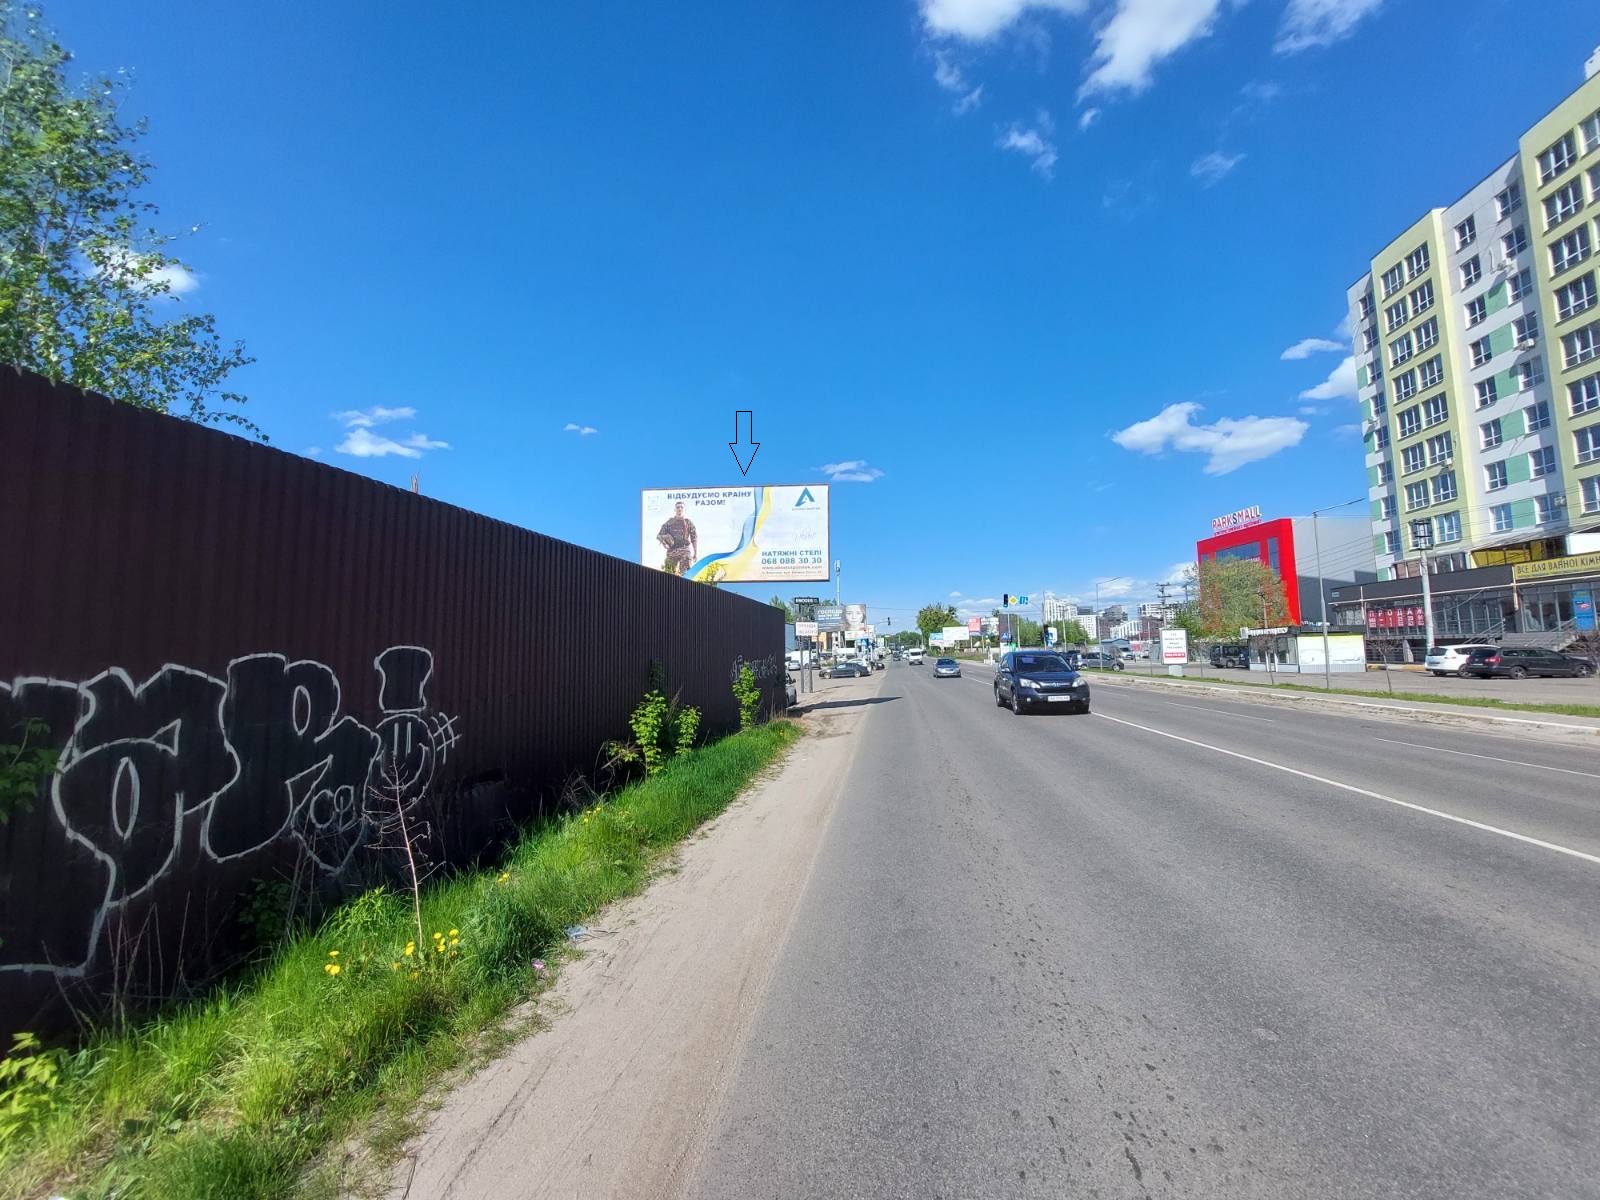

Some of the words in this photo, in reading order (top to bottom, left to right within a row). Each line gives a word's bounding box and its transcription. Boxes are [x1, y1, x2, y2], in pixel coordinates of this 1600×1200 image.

[1211, 504, 1262, 529] PARKSMALL
[761, 557, 777, 565] 068
[780, 557, 796, 565] 088
[799, 556, 809, 564] 30
[811, 556, 822, 564] 30
